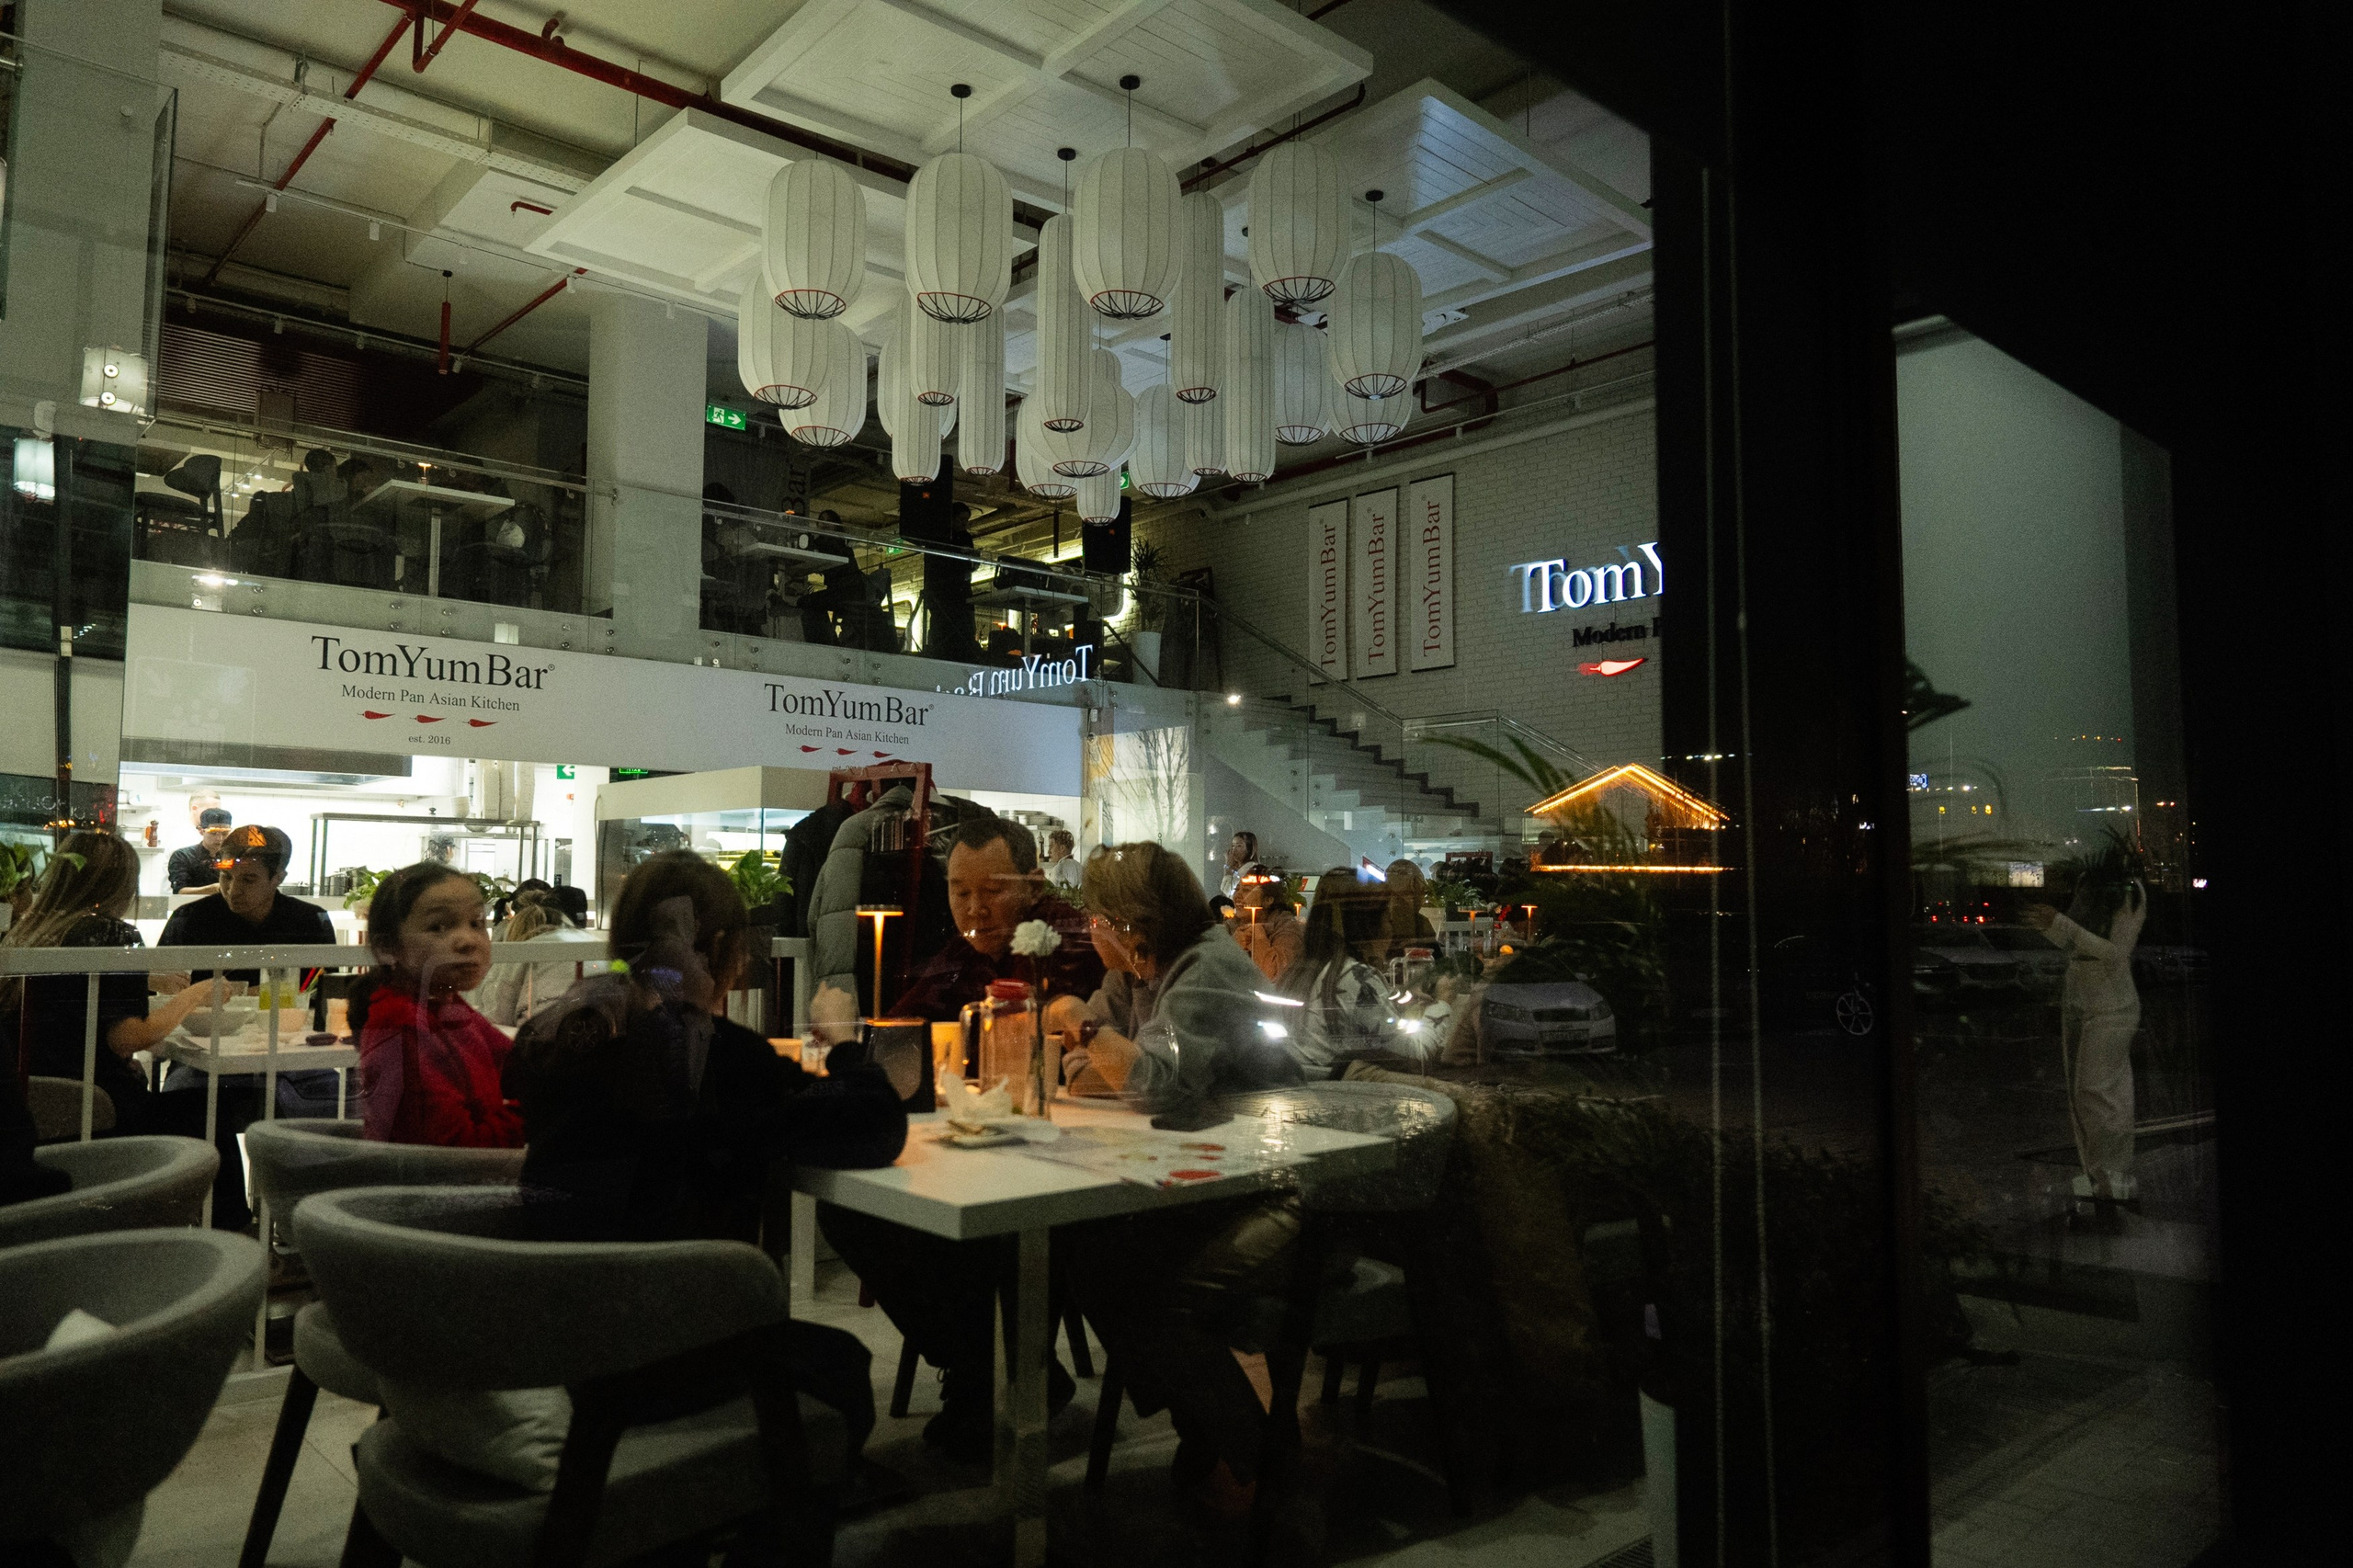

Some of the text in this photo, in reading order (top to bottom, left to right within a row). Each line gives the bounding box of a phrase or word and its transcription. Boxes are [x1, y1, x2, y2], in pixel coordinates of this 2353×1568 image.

[1321, 524, 1336, 668] TomYumBar
[1368, 514, 1385, 665] TomYumBar
[1423, 501, 1440, 657] TomYumBar
[1572, 622, 1646, 647] Modern
[311, 635, 548, 690] TomYumBar
[341, 684, 520, 711] Modern Pan Asian Kitchen
[764, 683, 929, 726] TomYumBar
[408, 734, 451, 745] est. 2016
[785, 723, 909, 744] Modern Pan Asian Kitchen
